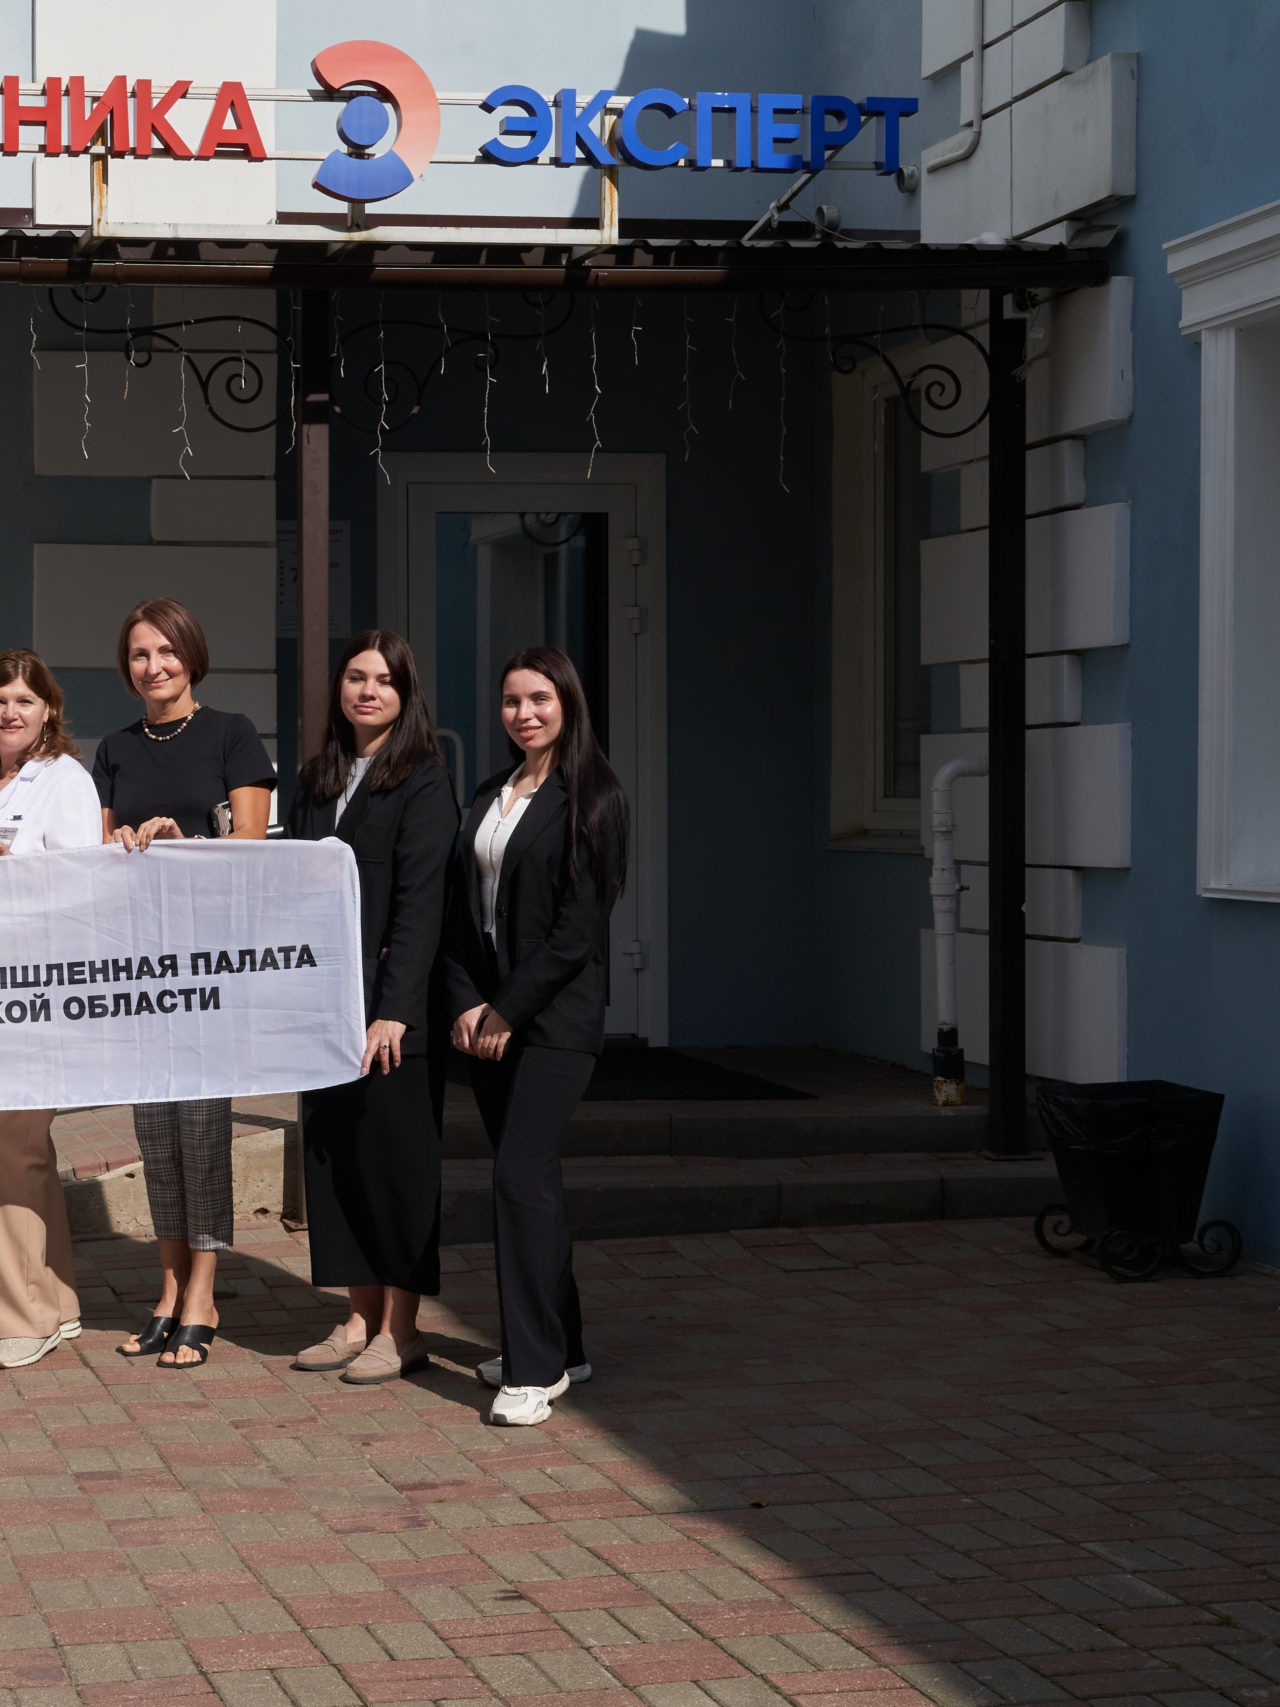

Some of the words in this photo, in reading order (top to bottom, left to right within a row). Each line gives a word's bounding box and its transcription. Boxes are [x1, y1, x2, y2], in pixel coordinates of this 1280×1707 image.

[478, 83, 919, 173] ЭКСПЕРТ
[189, 943, 318, 977] ПАЛАТА
[62, 986, 221, 1020] ОБЛАСТИ
